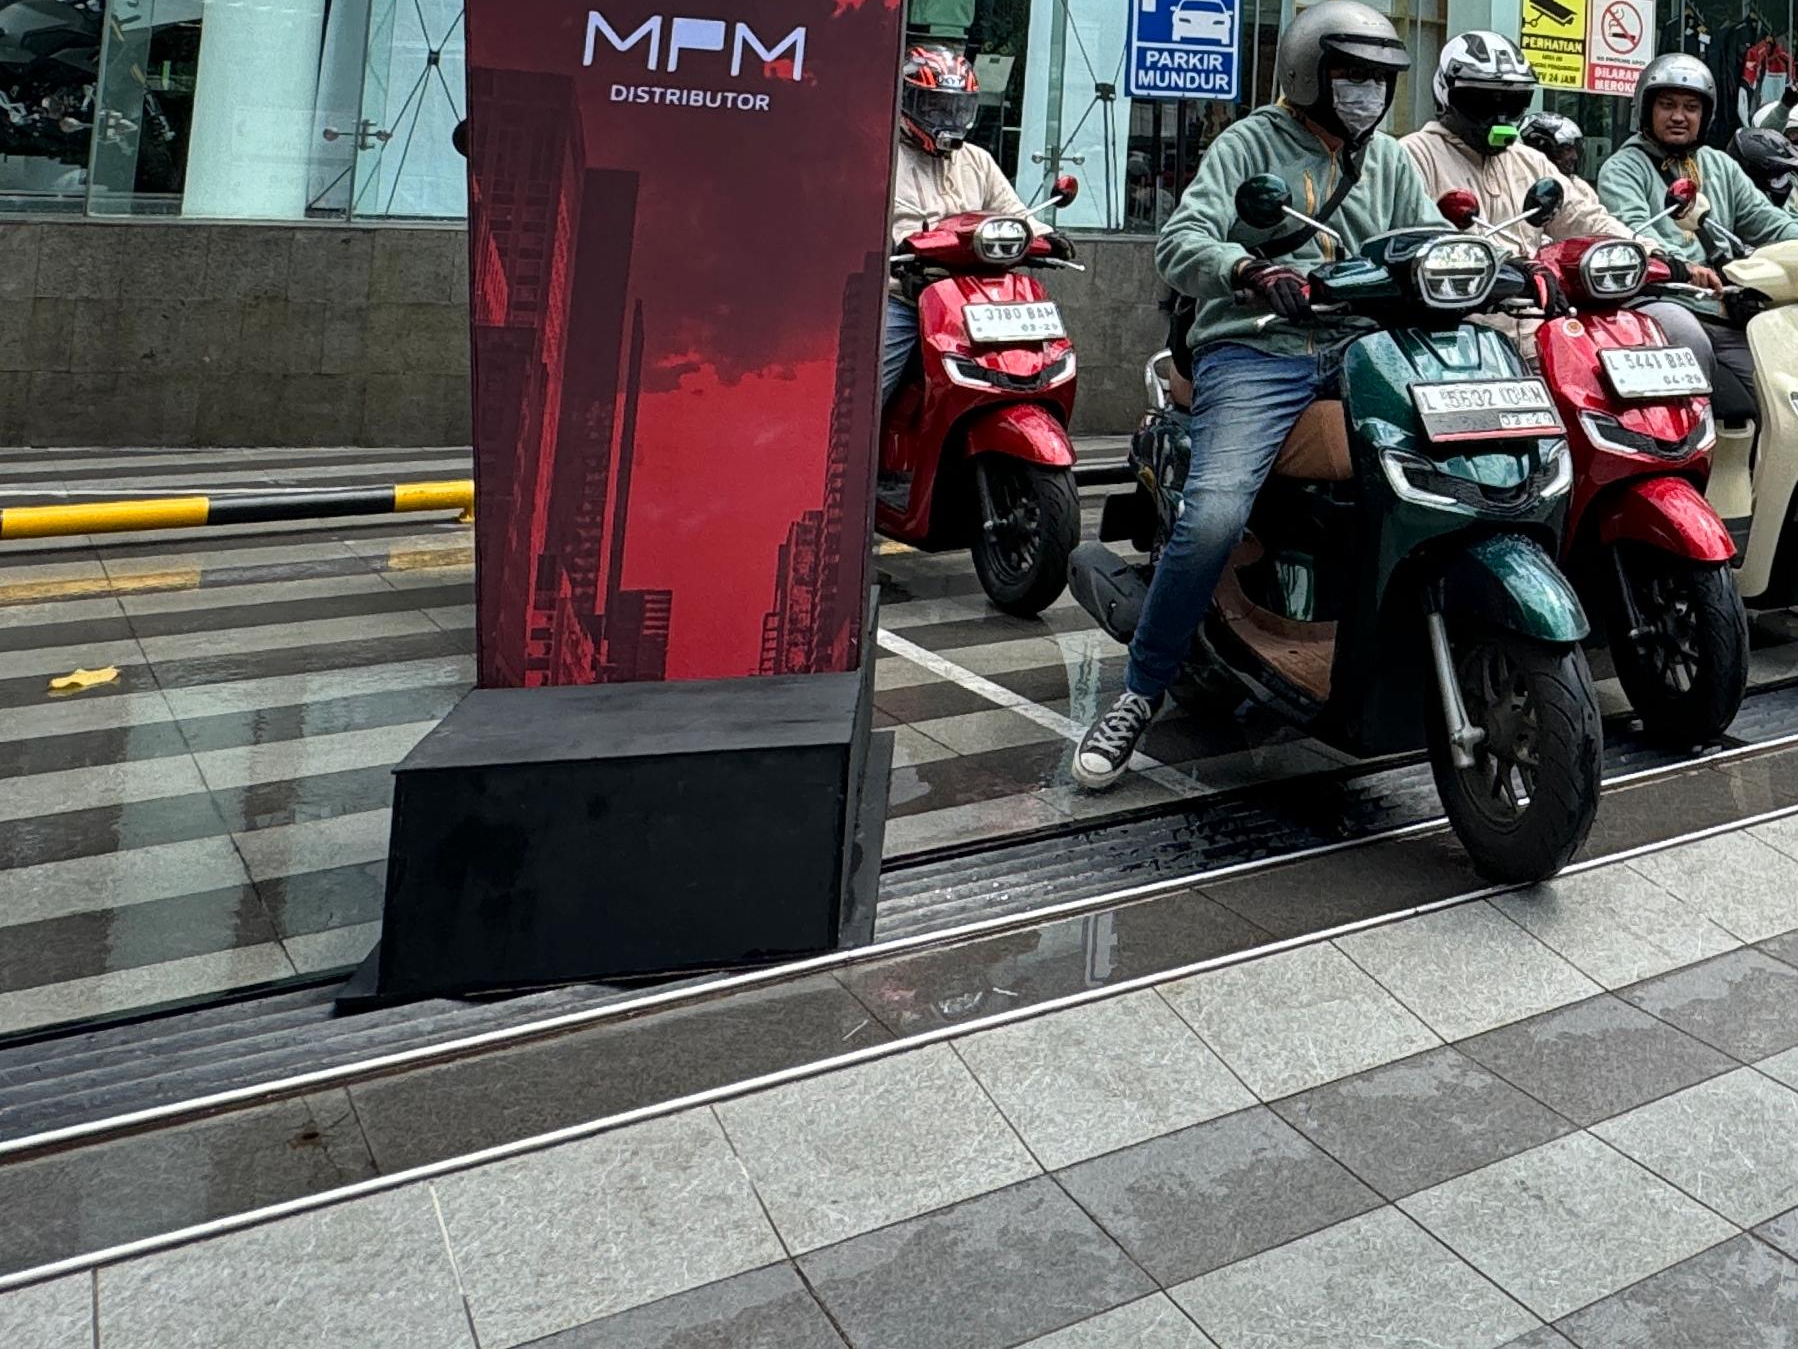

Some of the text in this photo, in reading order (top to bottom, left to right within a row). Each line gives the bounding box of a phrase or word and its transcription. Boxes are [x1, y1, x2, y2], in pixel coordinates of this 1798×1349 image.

[583, 10, 807, 82] MPM
[1521, 36, 1583, 53] PERHATIAN
[1146, 50, 1223, 71] PARKIR
[1138, 70, 1229, 91] MUNDUR
[1594, 66, 1641, 81] DILARAN
[610, 84, 770, 111] DISTRIBUTOR
[1421, 391, 1437, 411] L
